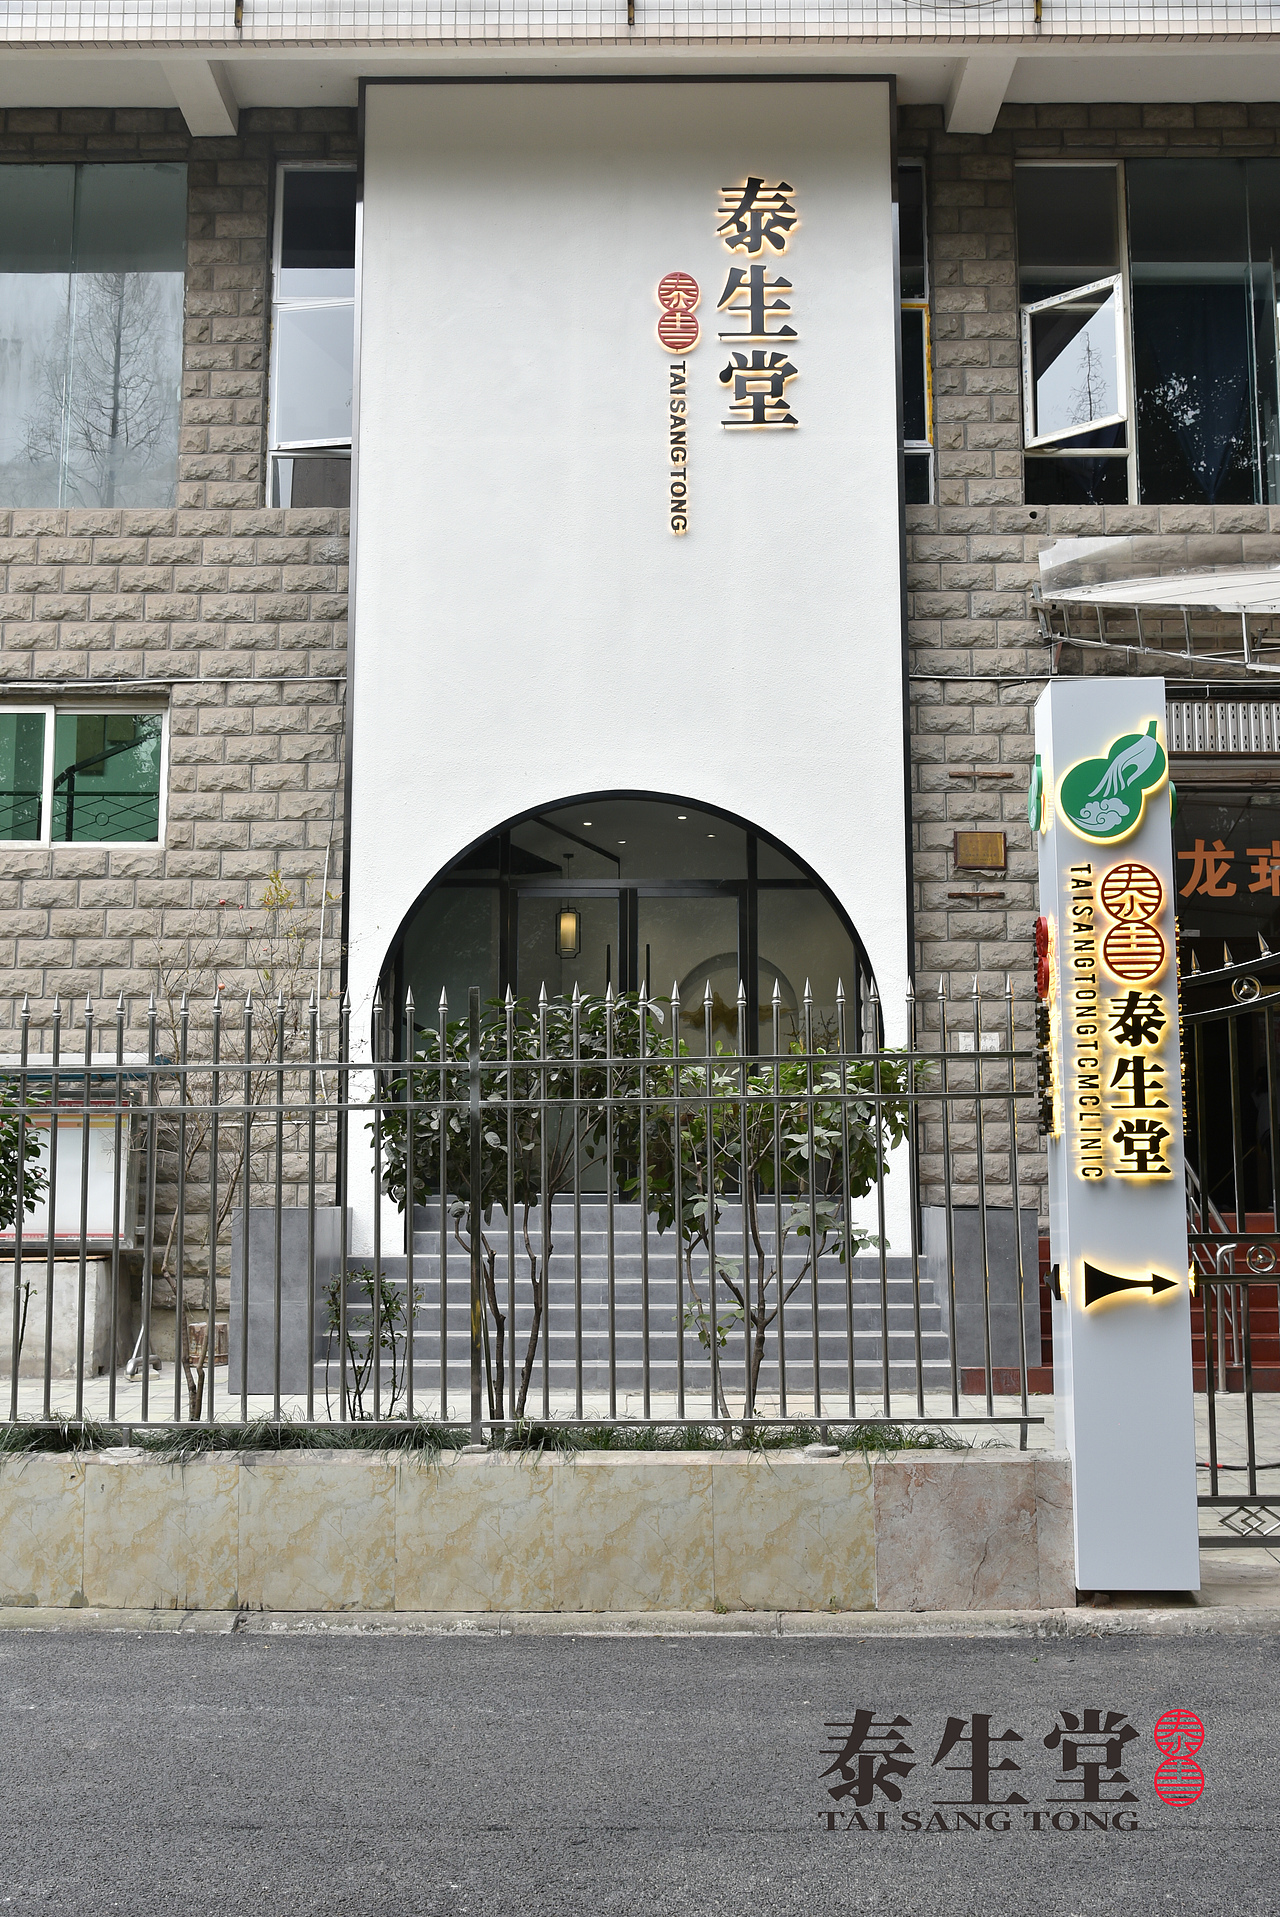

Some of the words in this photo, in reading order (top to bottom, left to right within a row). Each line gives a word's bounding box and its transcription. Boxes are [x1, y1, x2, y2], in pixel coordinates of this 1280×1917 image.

[716, 177, 798, 426] 泰生堂
[669, 360, 686, 395] TAI
[669, 399, 686, 463] SANG
[670, 467, 687, 534] TONG
[1108, 990, 1171, 1174] 泰生堂
